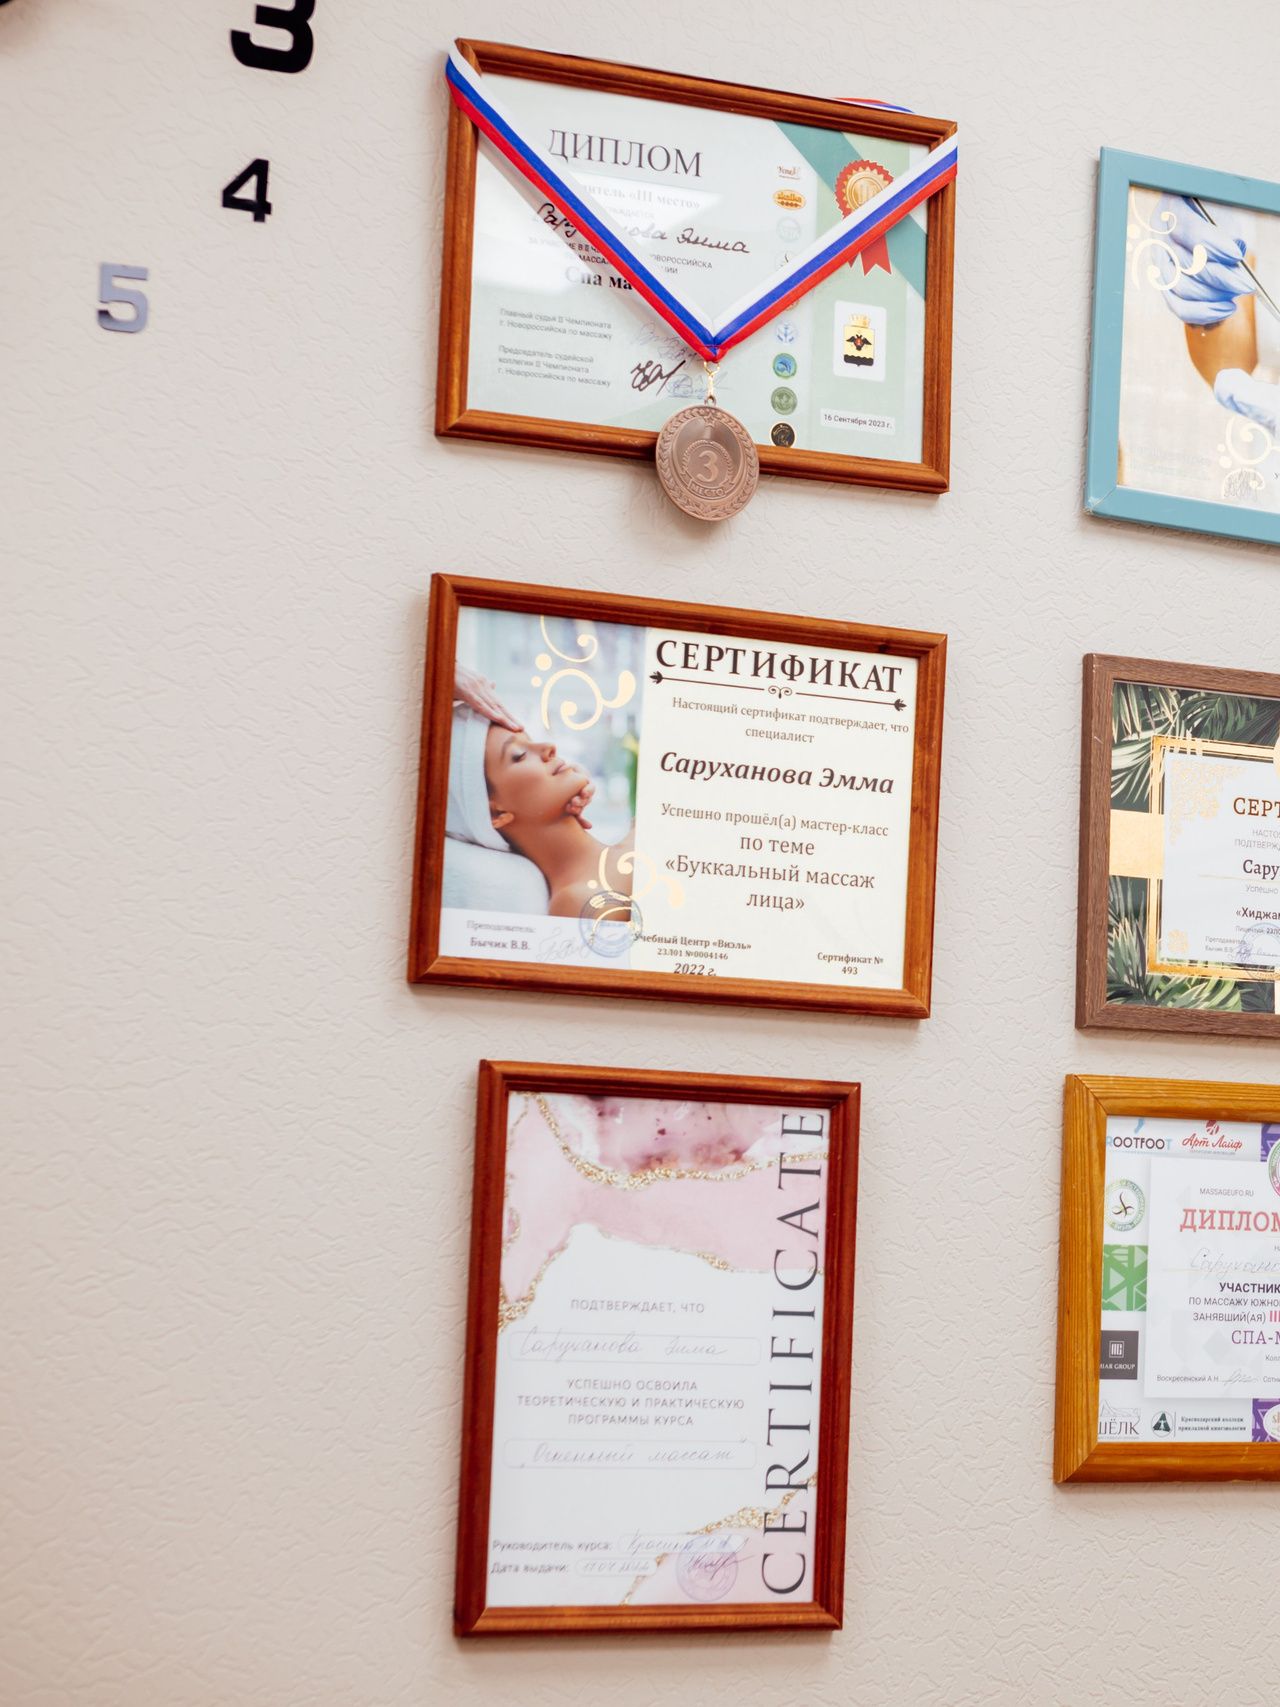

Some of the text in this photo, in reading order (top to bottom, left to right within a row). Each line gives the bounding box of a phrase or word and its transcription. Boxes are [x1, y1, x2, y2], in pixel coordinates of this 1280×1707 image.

[548, 129, 703, 177] ДИПЛОМ
[222, 158, 271, 223] 4
[97, 262, 149, 333] 5
[824, 413, 885, 428] 16 Сентября 2023
[695, 451, 718, 483] 3
[690, 482, 725, 497] МЕСТО
[656, 639, 902, 693] СЕРТИФИКАТ
[672, 697, 909, 733] Настоящий сертификат подтверждает, что
[745, 727, 815, 744] специалист
[660, 751, 894, 794] Саруханова Эмма
[661, 803, 889, 837] Успешно прошёл(а) мастер-класс
[740, 836, 815, 856] по теме
[665, 855, 875, 889] «Буккальный массаж
[1246, 884, 1278, 896] Успешно
[746, 893, 805, 912] лица»
[470, 937, 531, 950] Бычик В.В.
[680, 935, 752, 950] Центр «Виэль»
[817, 952, 872, 965] Сертификат
[673, 962, 705, 976] 2022
[841, 966, 858, 976] 493
[1106, 1136, 1173, 1150] ROOTFOOT
[1182, 1133, 1243, 1151] Арт Лайф
[1200, 1188, 1254, 1196] MASSAGEUFO.RU
[1219, 1282, 1280, 1294] УЧАСТНИК
[571, 1299, 705, 1314] ПОДТВЕРЖДАЕТ, ЧТО
[1189, 1297, 1201, 1305] ПО
[1204, 1298, 1248, 1307] МАССАЖУ
[1193, 1311, 1266, 1324] ЗАНЯВШИЙ(АЯ)
[762, 1113, 825, 1594] CERTIFICATE
[567, 1378, 698, 1392] УСПЕШНО ОСВОИЛА
[517, 1394, 745, 1410] ТЕОРЕТИЧЕСКУЮ И ПРАКТИЧЕСКУЮ
[567, 1413, 694, 1426] ПРОГРАММЫ КУРСА
